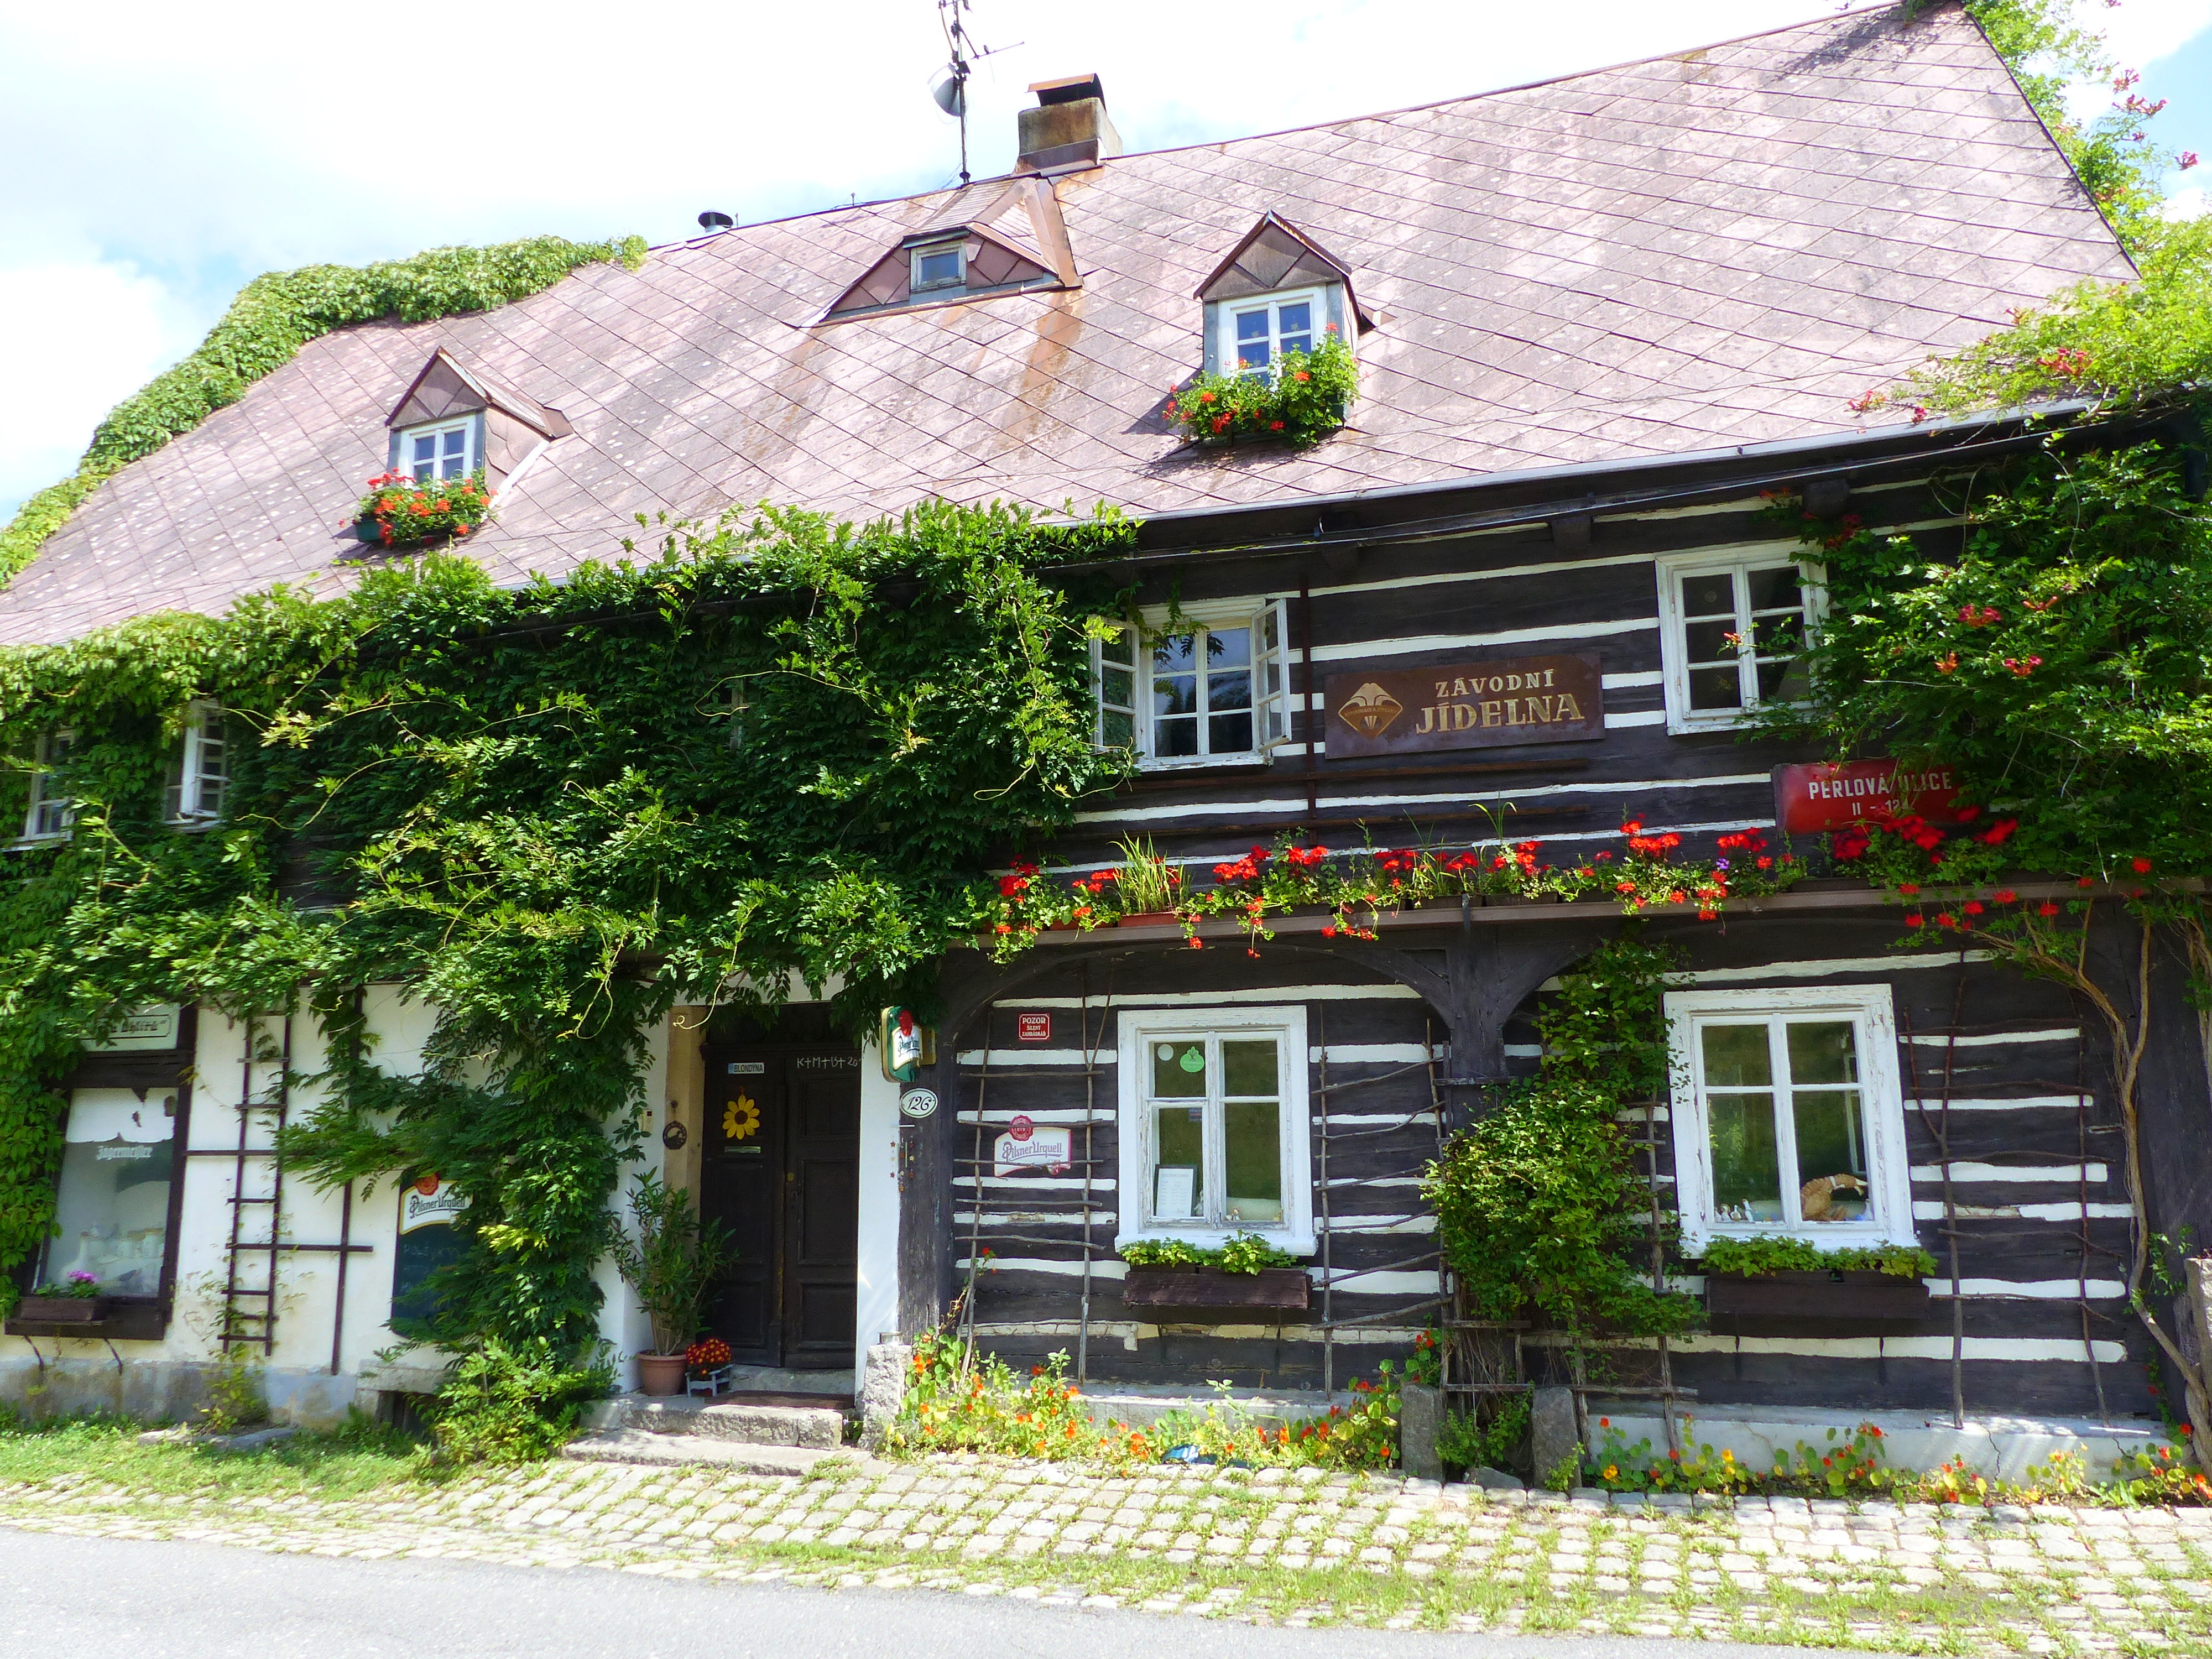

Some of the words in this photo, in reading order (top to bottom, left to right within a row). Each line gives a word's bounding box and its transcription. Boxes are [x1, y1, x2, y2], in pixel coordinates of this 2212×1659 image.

[1436, 669, 1555, 698] ZÁVODNÍ
[1416, 693, 1585, 734] JÍDELNA
[1808, 773, 1890, 800] PERLOVÁ
[907, 1096, 932, 1111] 126
[1001, 1141, 1033, 1162] Pilsner
[1032, 1140, 1062, 1157] Urquell
[410, 1195, 439, 1219] Pilsner
